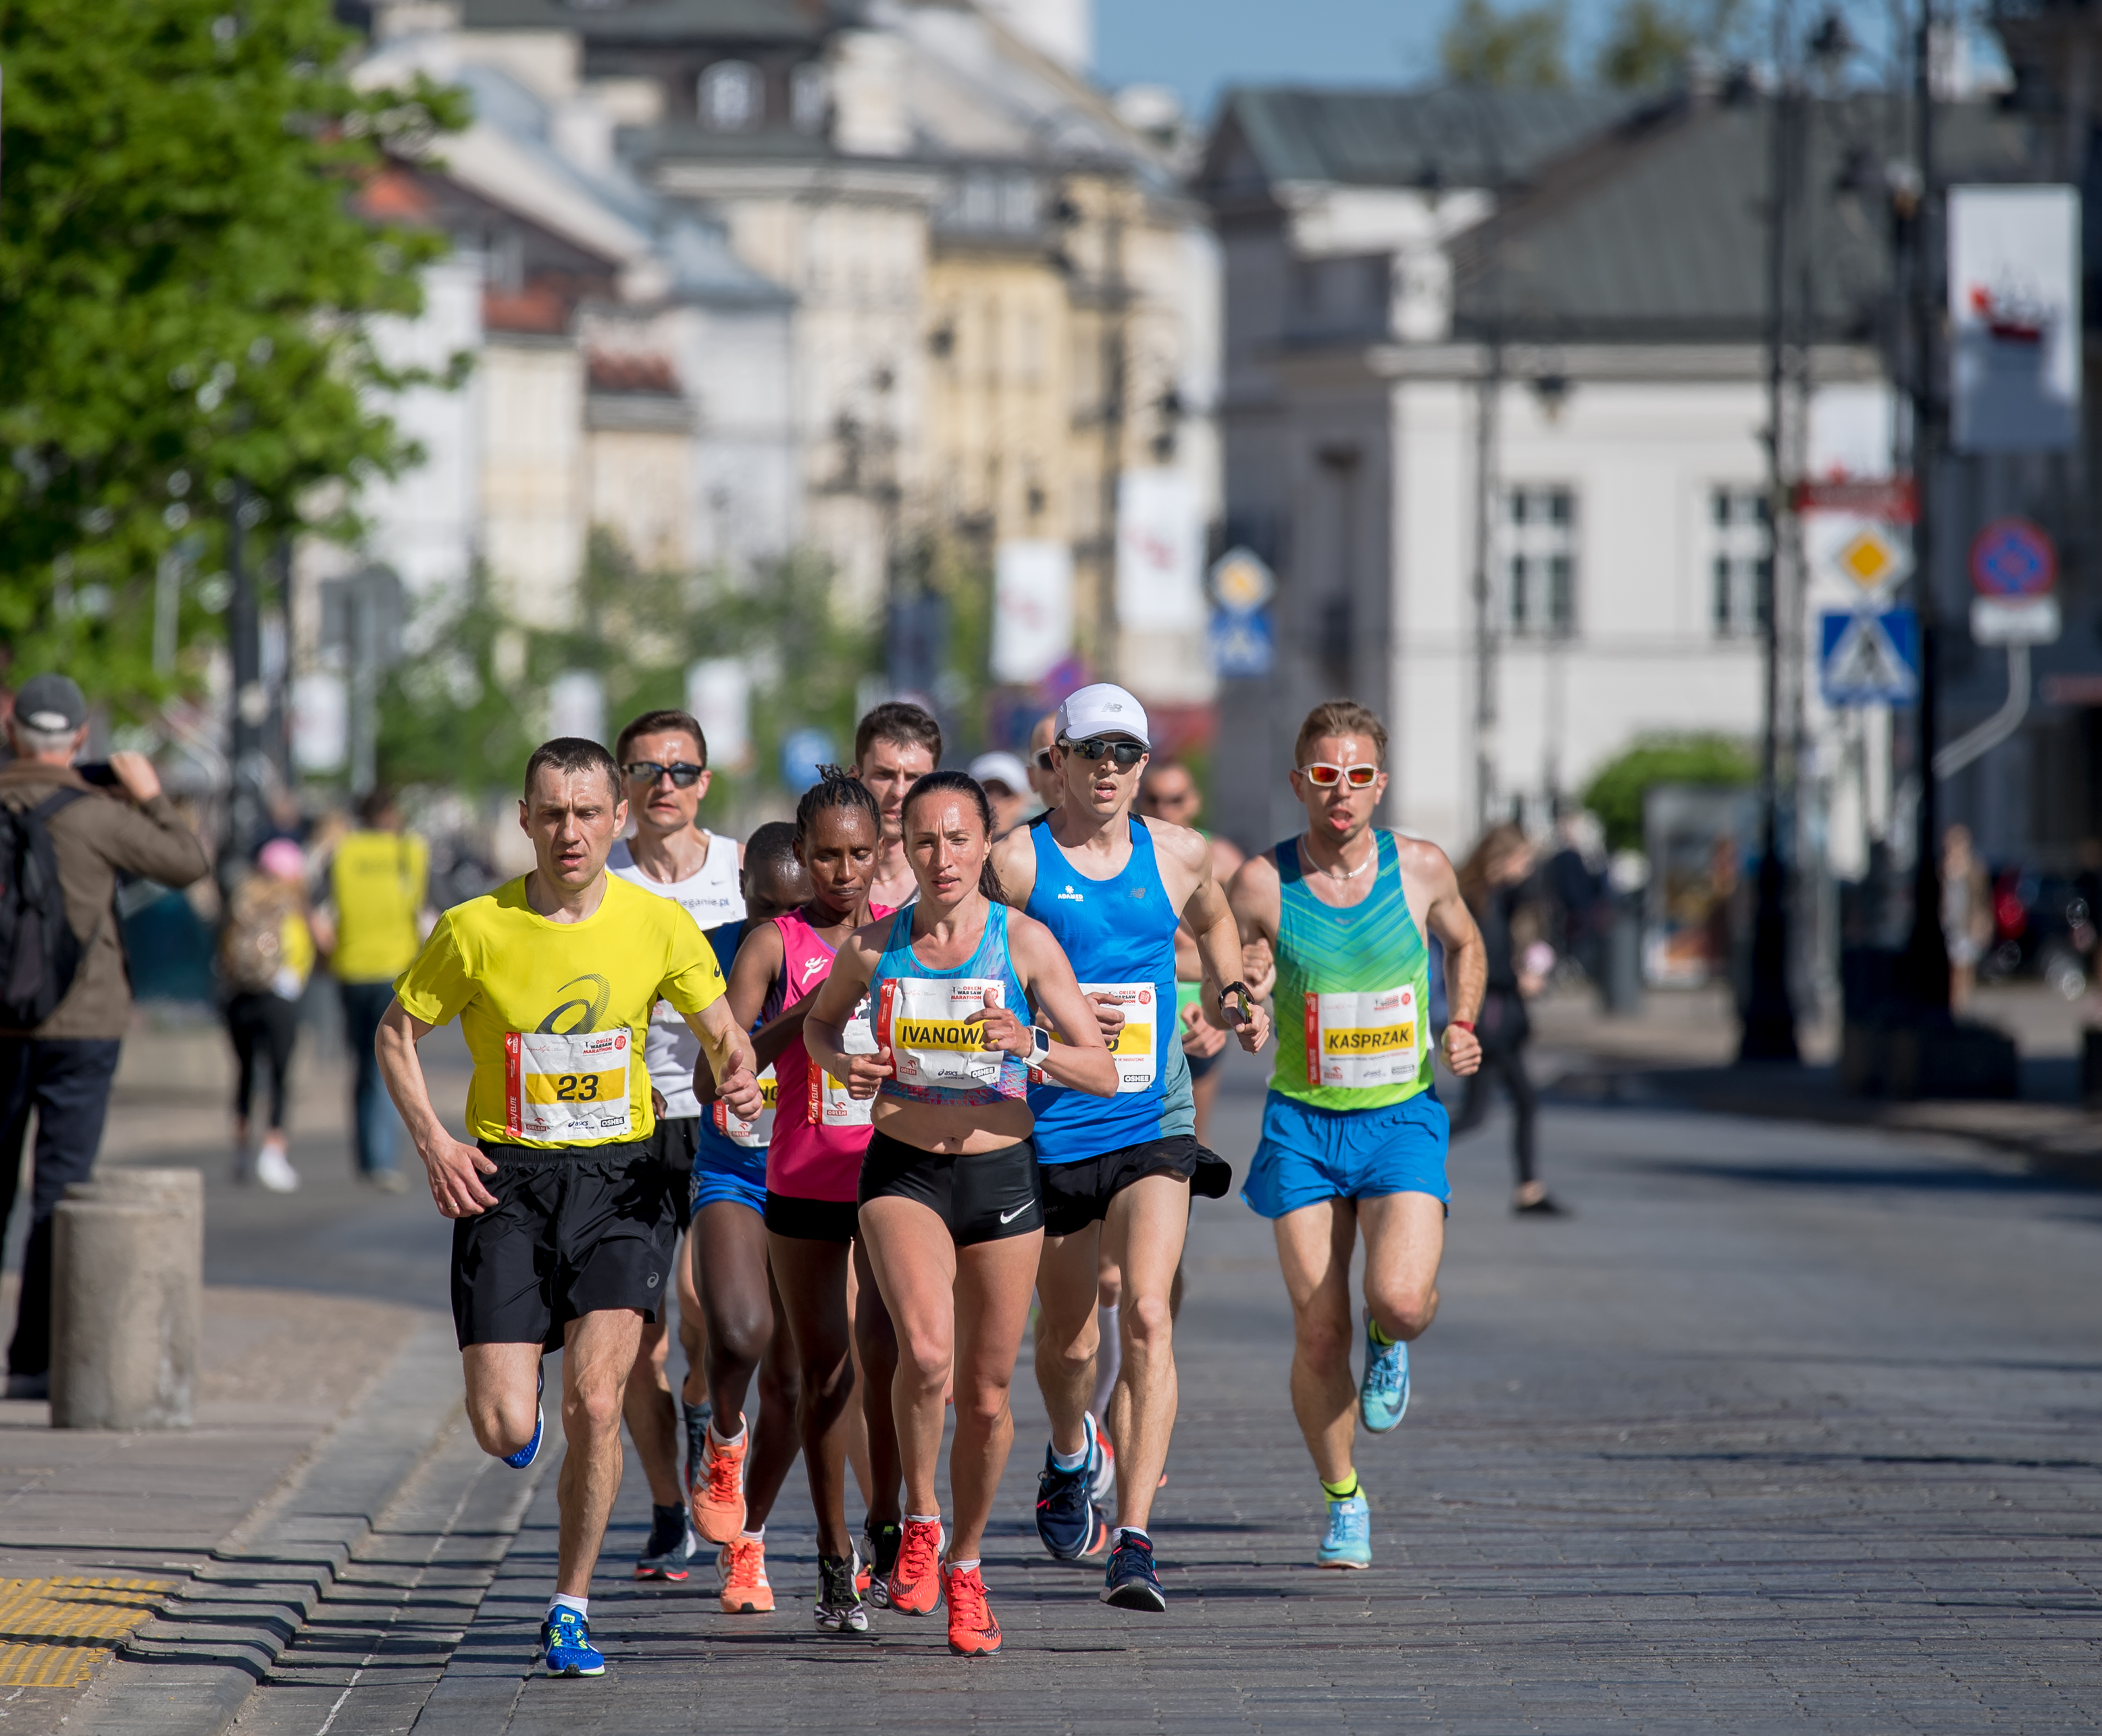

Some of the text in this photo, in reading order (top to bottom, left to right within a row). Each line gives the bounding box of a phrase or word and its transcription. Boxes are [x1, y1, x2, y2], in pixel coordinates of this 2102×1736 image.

[677, 898, 729, 909] ieganie.pl
[902, 1025, 983, 1044] IVANOW
[1329, 1028, 1410, 1049] KASPRZAK
[583, 1046, 613, 1054] MARATHON
[972, 1068, 994, 1078] OSHEE
[557, 1075, 599, 1101] 23
[601, 1117, 623, 1126] OSHEE
